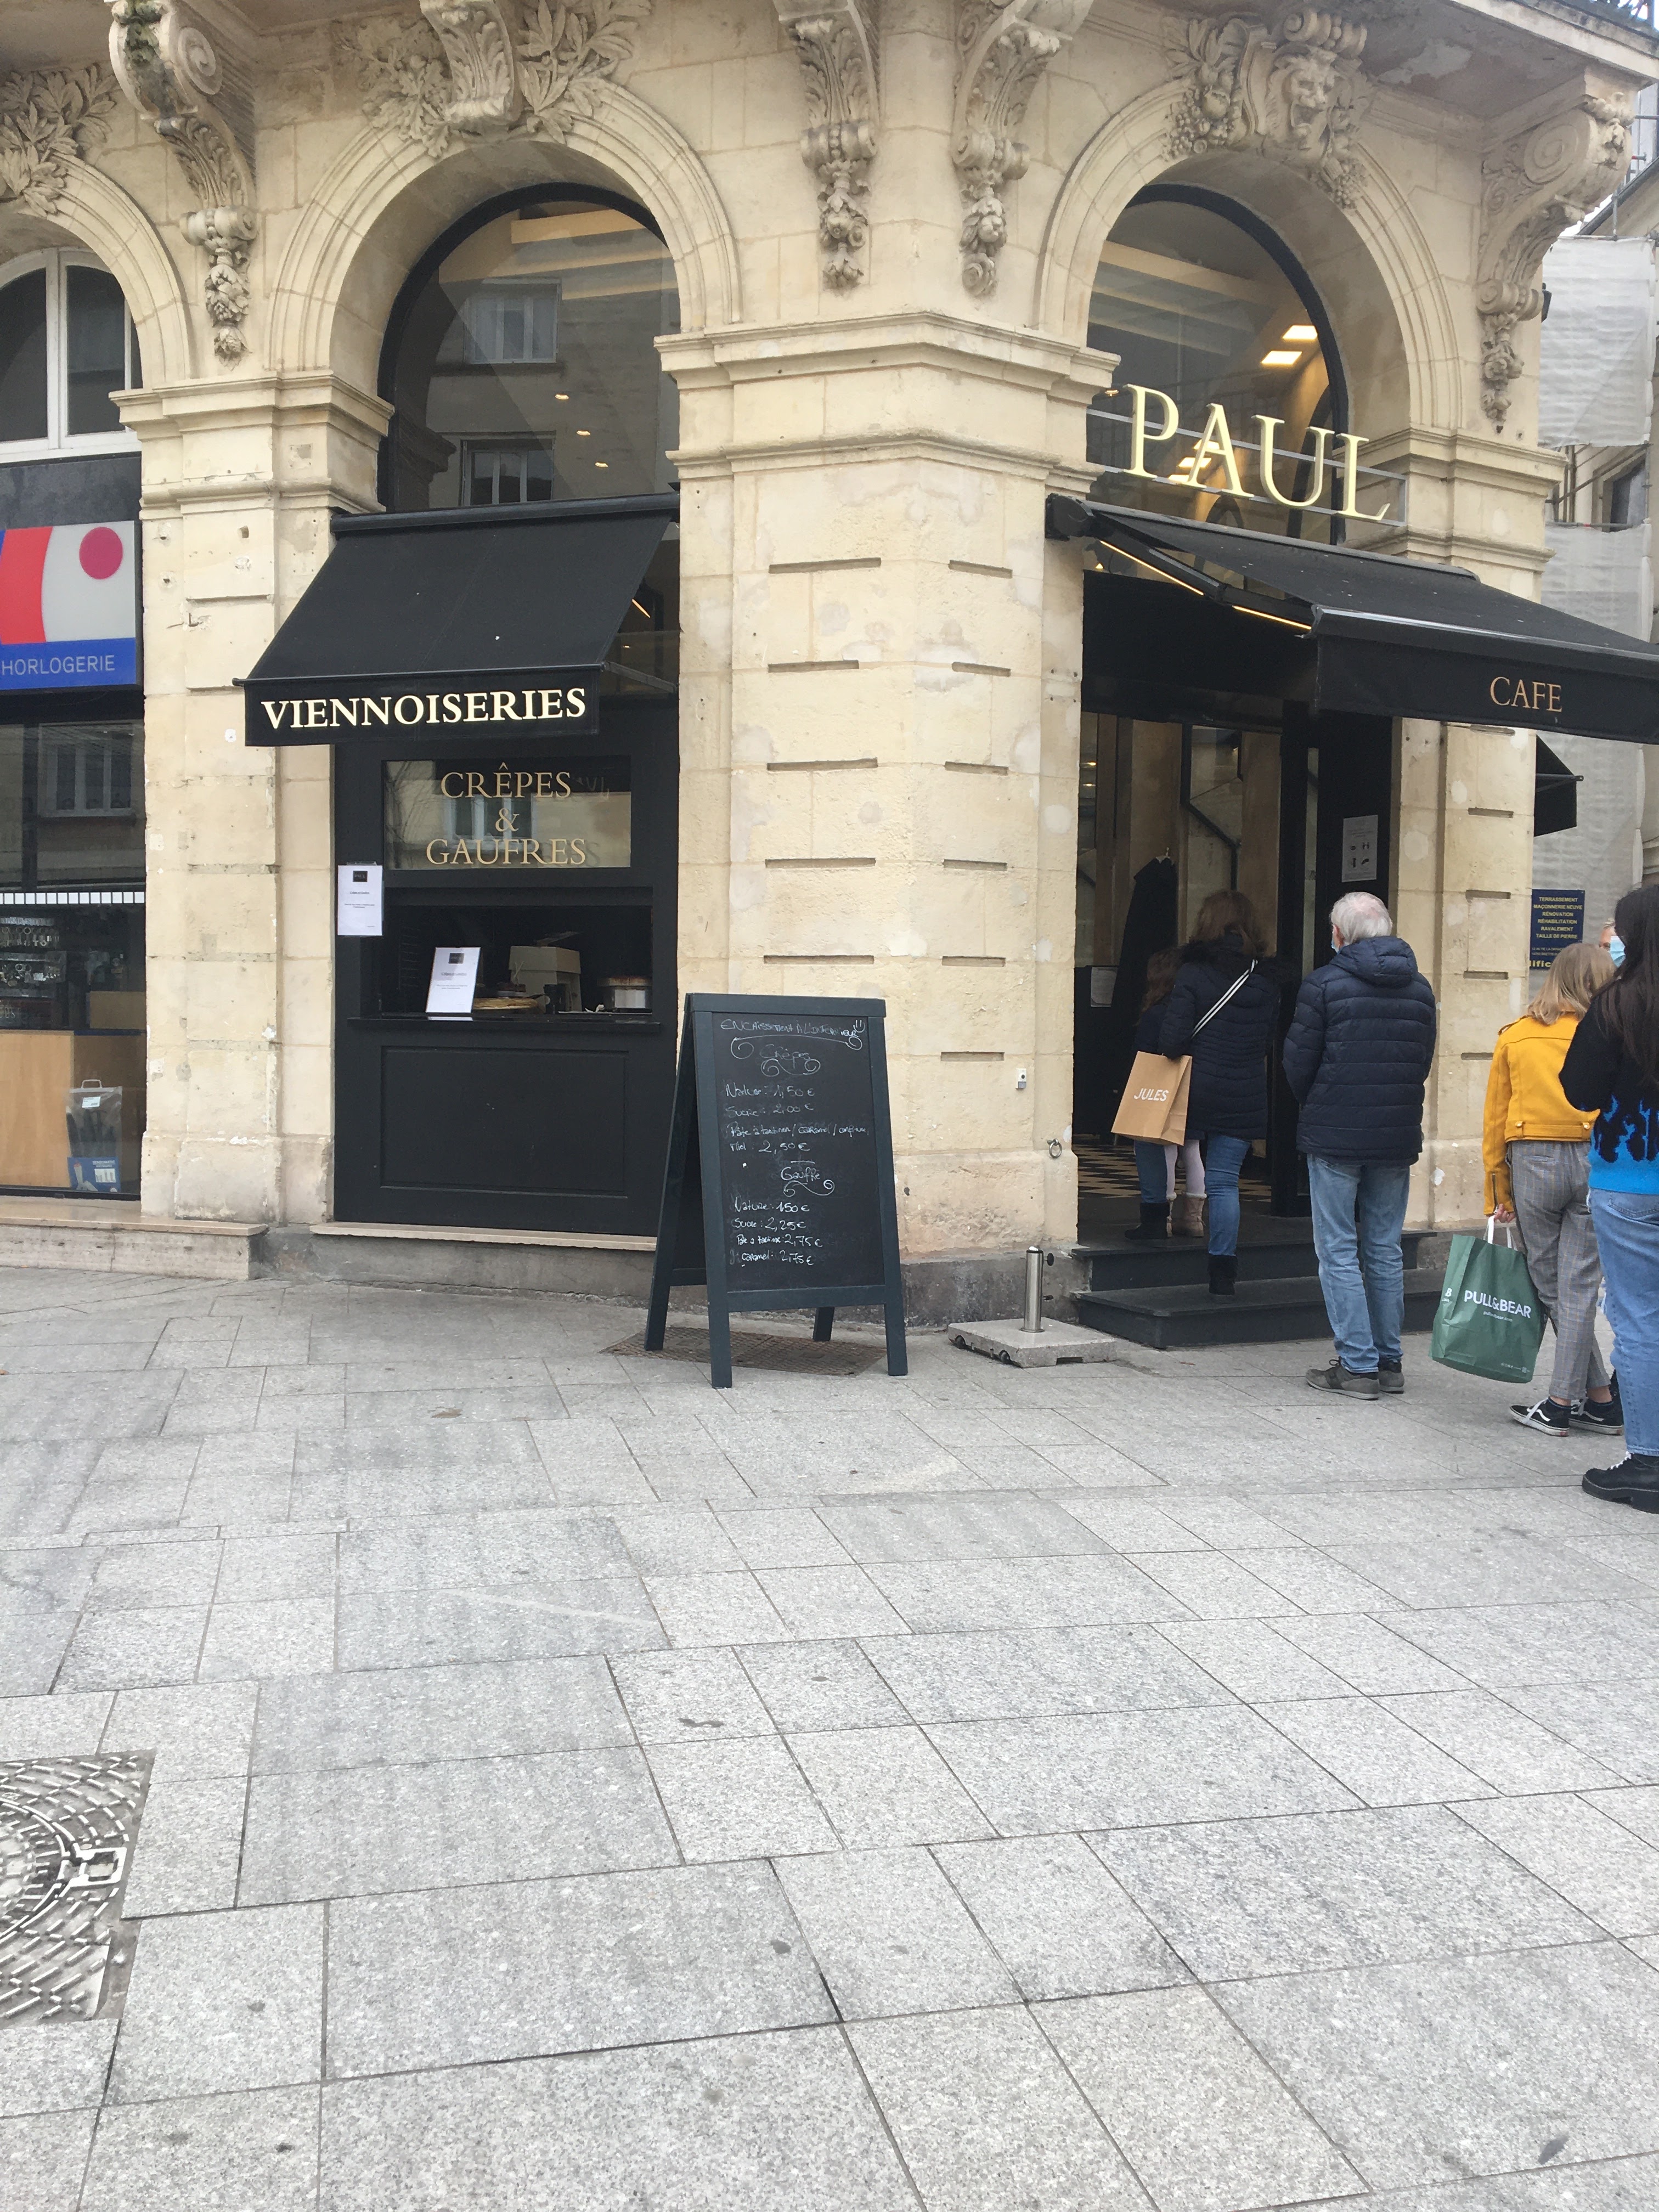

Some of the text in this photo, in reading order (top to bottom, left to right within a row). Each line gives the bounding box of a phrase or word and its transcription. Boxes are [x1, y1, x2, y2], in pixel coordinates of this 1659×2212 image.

[1122, 383, 1391, 521] PAUL
[2, 654, 115, 675] HORLOGERIE
[261, 687, 586, 729] VIENNOISERIES
[1490, 676, 1563, 713] CAFE
[441, 761, 571, 799] CRÊPES
[495, 808, 520, 832] &
[426, 838, 586, 865] GAUFRES
[1133, 1088, 1169, 1102] JULES
[1464, 1290, 1531, 1318] PULL&BEAR
